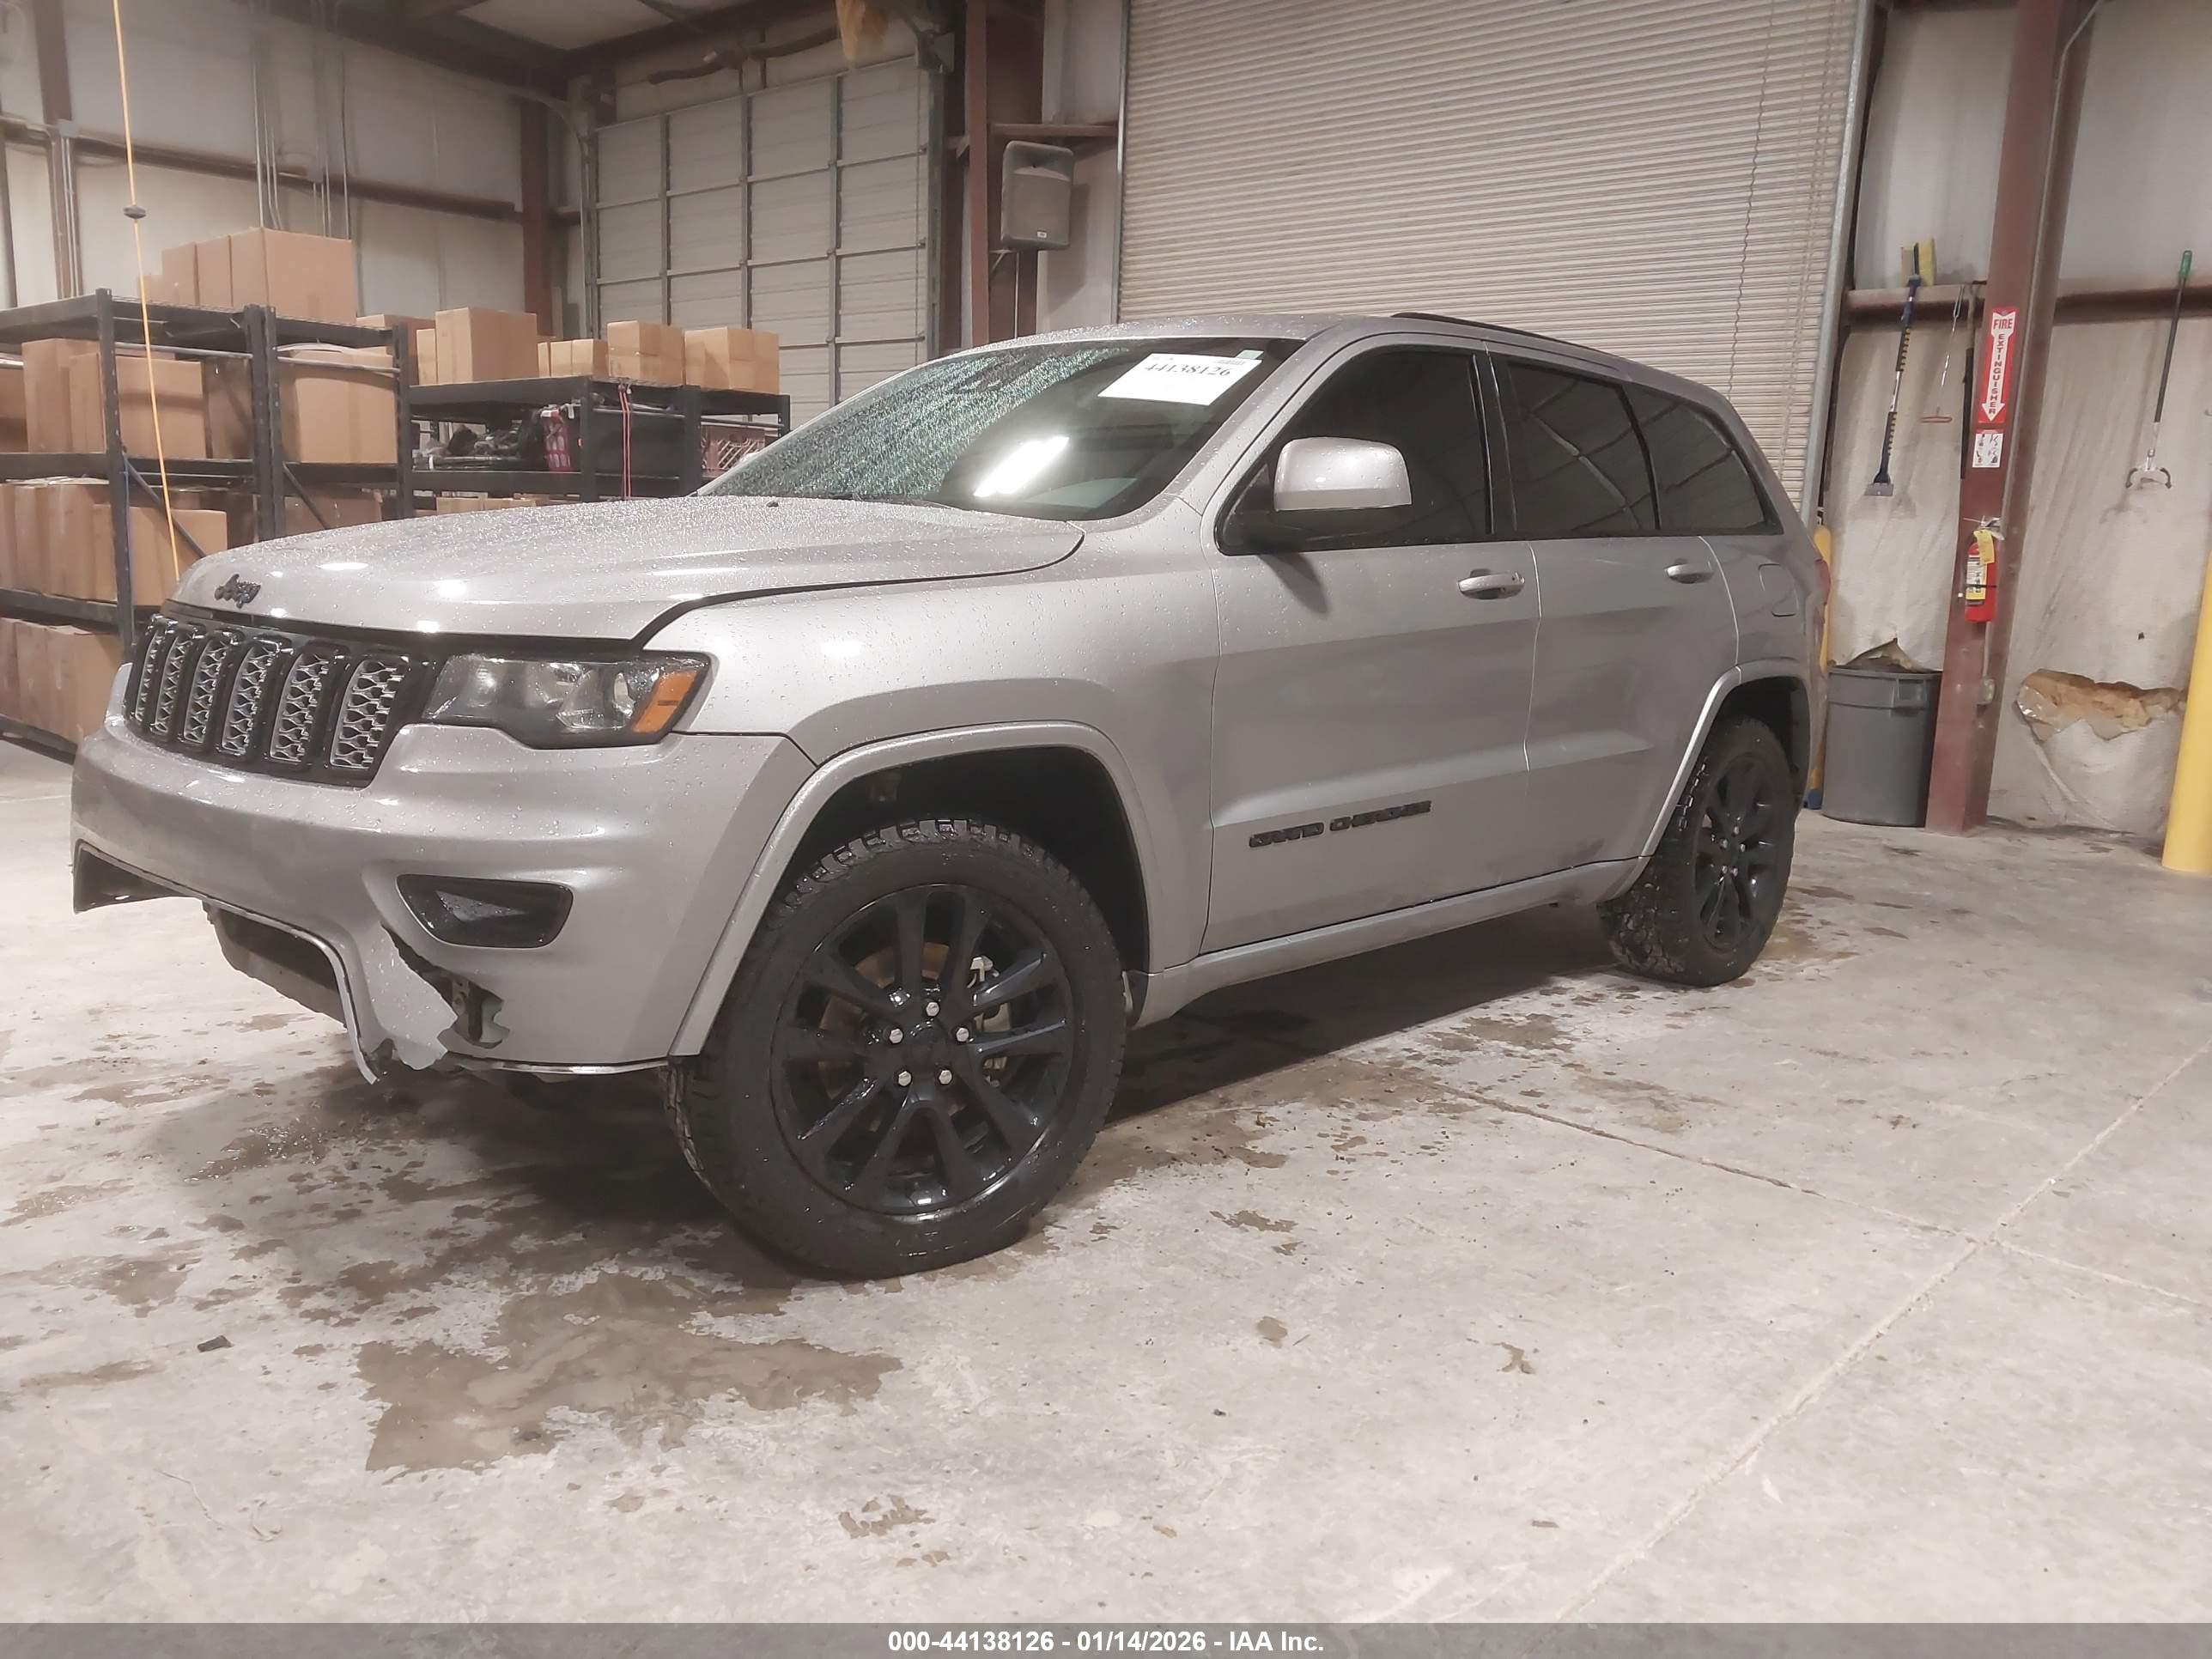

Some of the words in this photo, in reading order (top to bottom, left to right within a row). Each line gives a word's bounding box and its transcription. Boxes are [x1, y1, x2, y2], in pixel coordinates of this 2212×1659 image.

[1993, 318, 2014, 330] FIRE
[1144, 363, 1232, 376] 44138126
[1988, 333, 2006, 415] EXTINGUISHER
[214, 574, 261, 609] Jeep
[1249, 822, 1324, 848] GRAND
[1329, 800, 1431, 831] CHEROKEE
